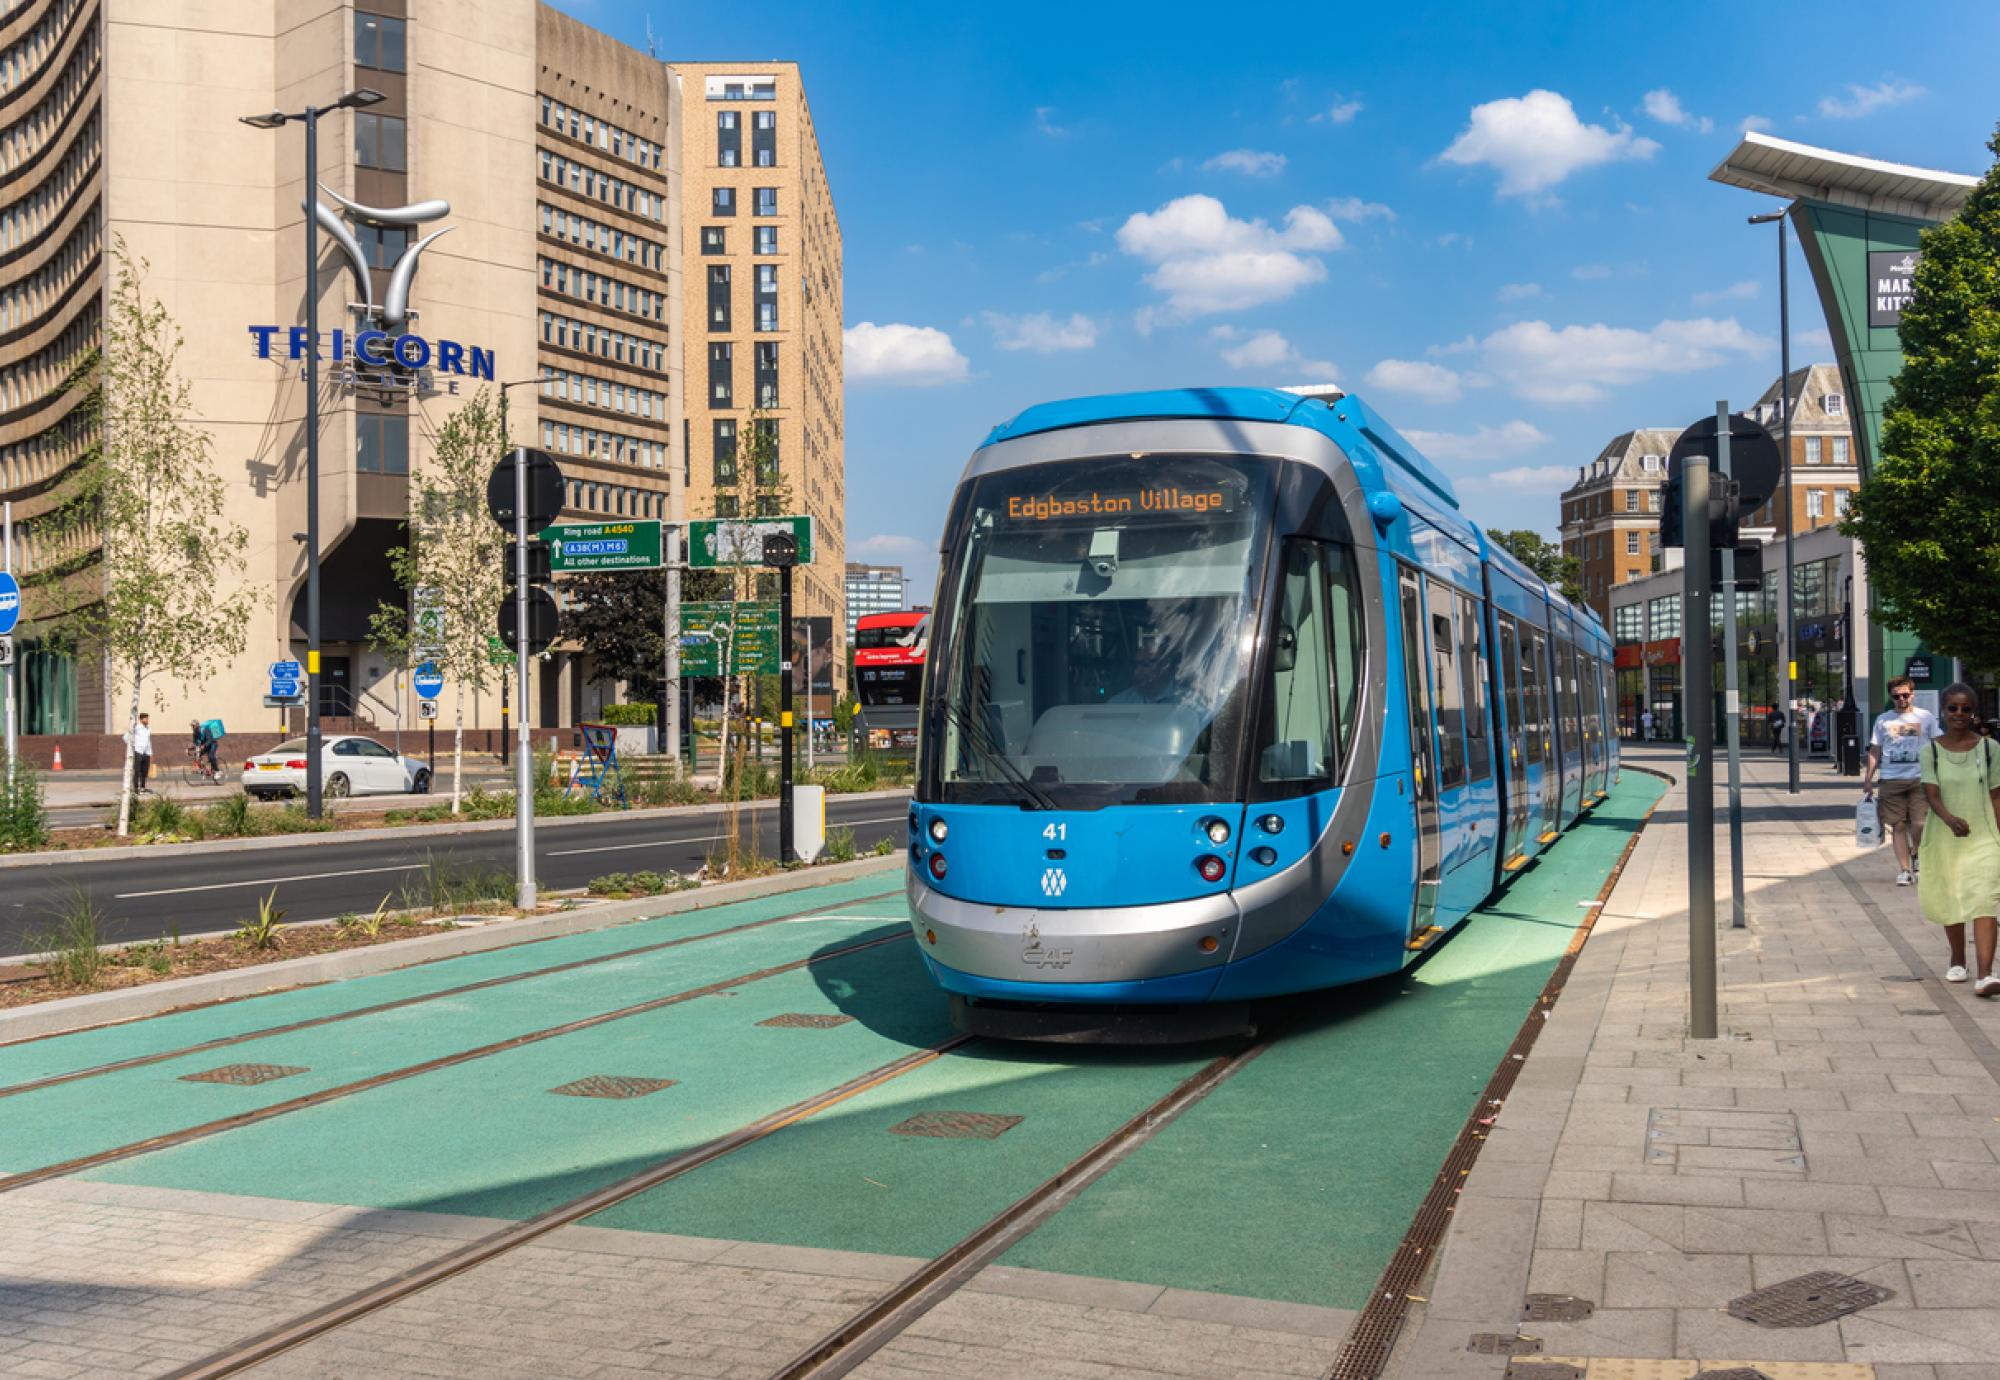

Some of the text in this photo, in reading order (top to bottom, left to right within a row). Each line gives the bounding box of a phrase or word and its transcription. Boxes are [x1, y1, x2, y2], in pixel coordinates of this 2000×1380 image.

[1878, 279, 1917, 293] MAR
[248, 326, 495, 382] TRICORN
[1009, 487, 1222, 520] Edgbaston Village
[564, 525, 634, 537] Ring road A4540
[563, 555, 651, 566] All other destinations
[1042, 823, 1067, 841] 41
